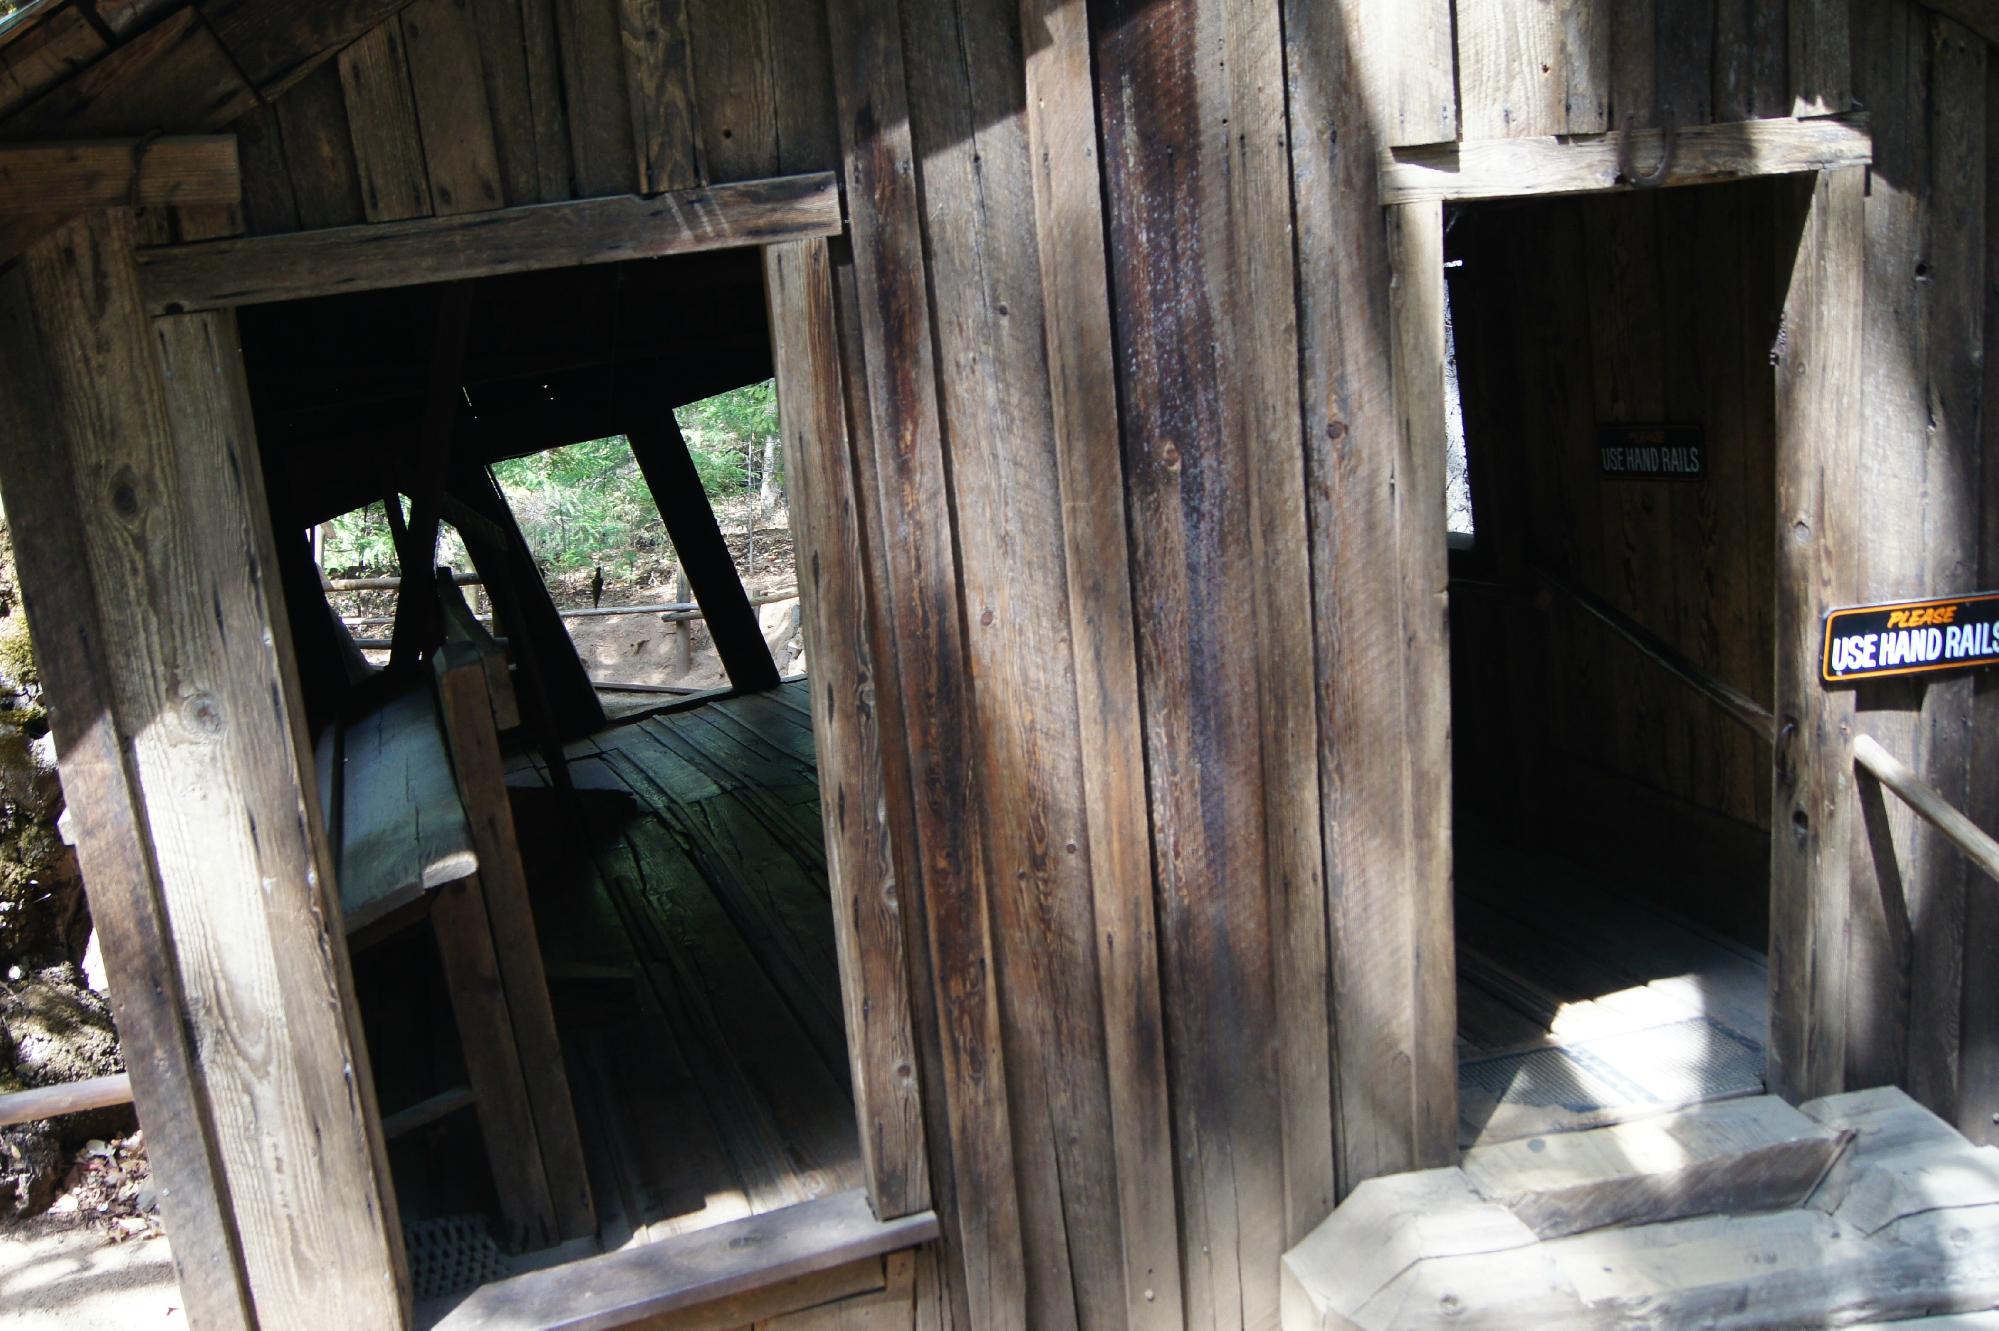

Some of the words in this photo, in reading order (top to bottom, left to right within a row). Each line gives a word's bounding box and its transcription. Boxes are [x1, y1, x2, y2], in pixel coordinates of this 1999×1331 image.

[1602, 447, 1625, 471] USE
[1626, 447, 1660, 472] HAND
[1662, 446, 1699, 472] RAILS
[1887, 606, 1957, 628] PLEASE
[1832, 634, 1878, 671] USE
[1879, 628, 1942, 666] HAND
